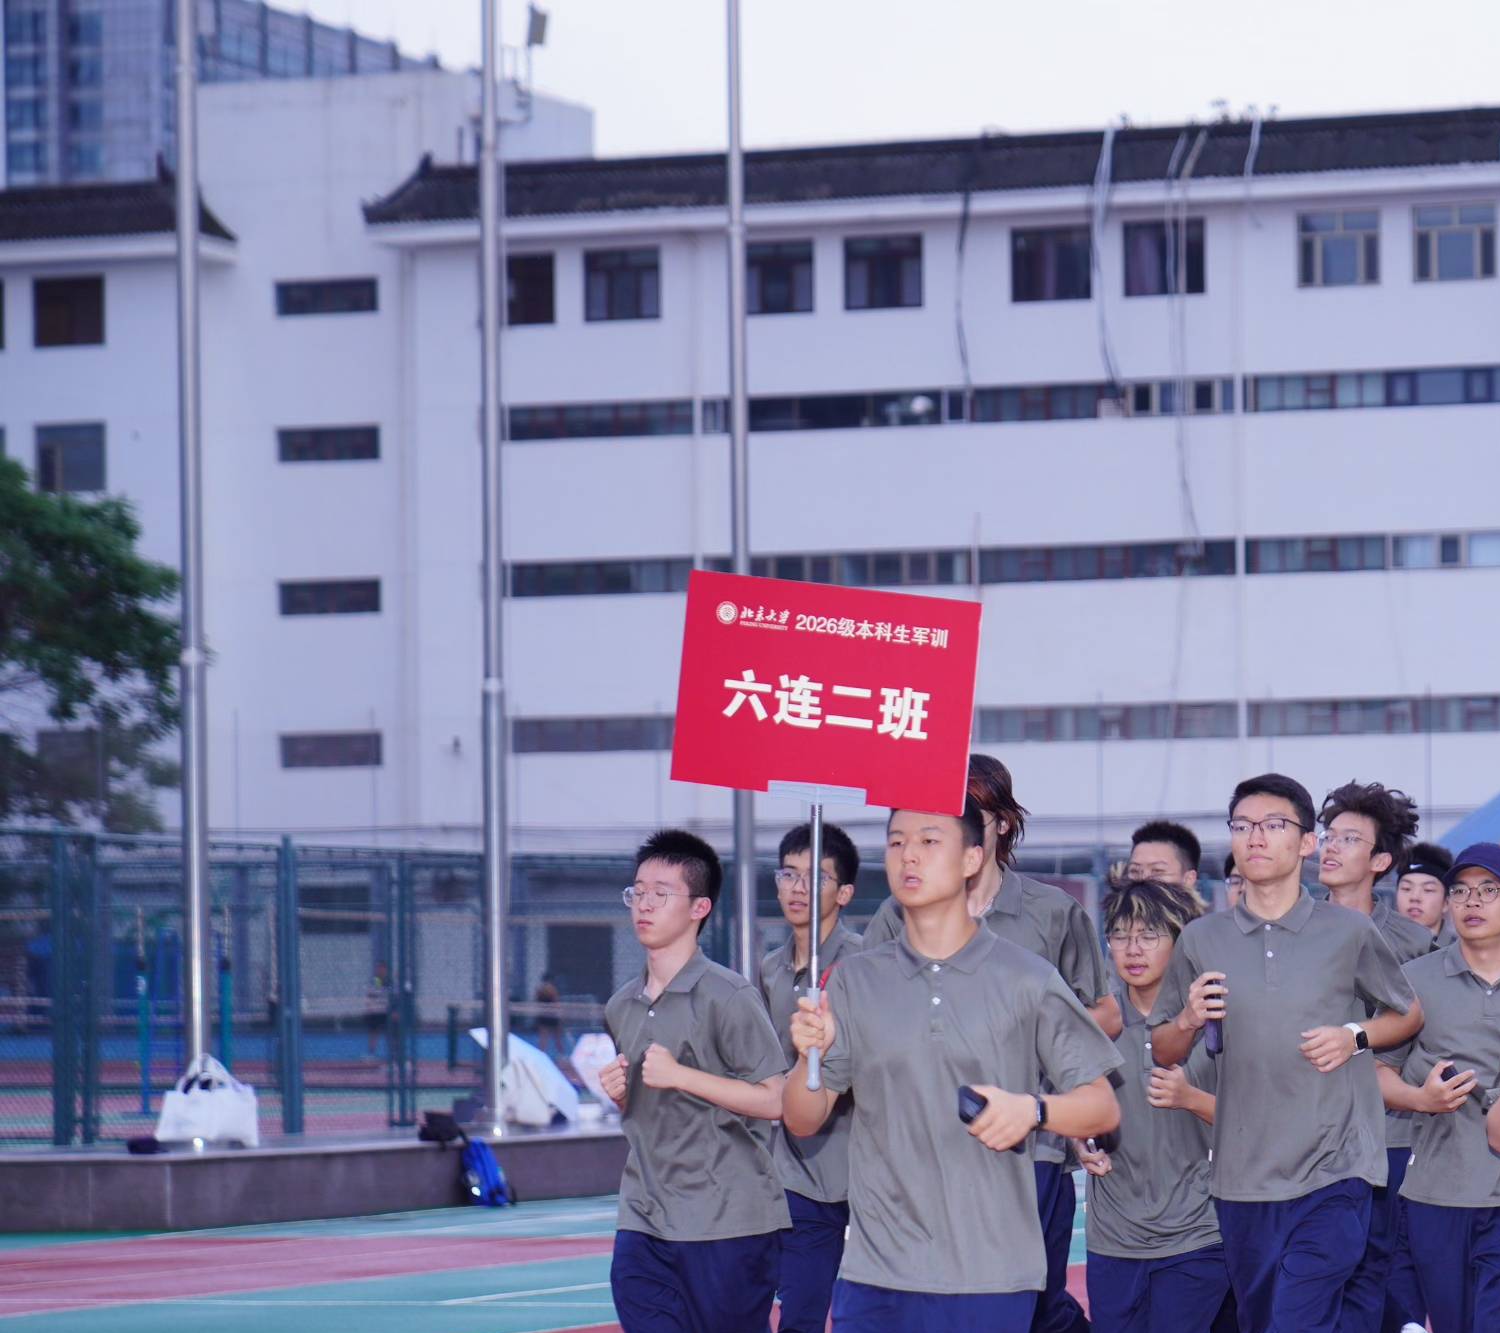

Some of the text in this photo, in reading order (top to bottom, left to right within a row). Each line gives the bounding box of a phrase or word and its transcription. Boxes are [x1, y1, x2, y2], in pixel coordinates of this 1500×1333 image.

[795, 613, 949, 648] 2026级本科生军训
[722, 669, 931, 741] 六连二班
